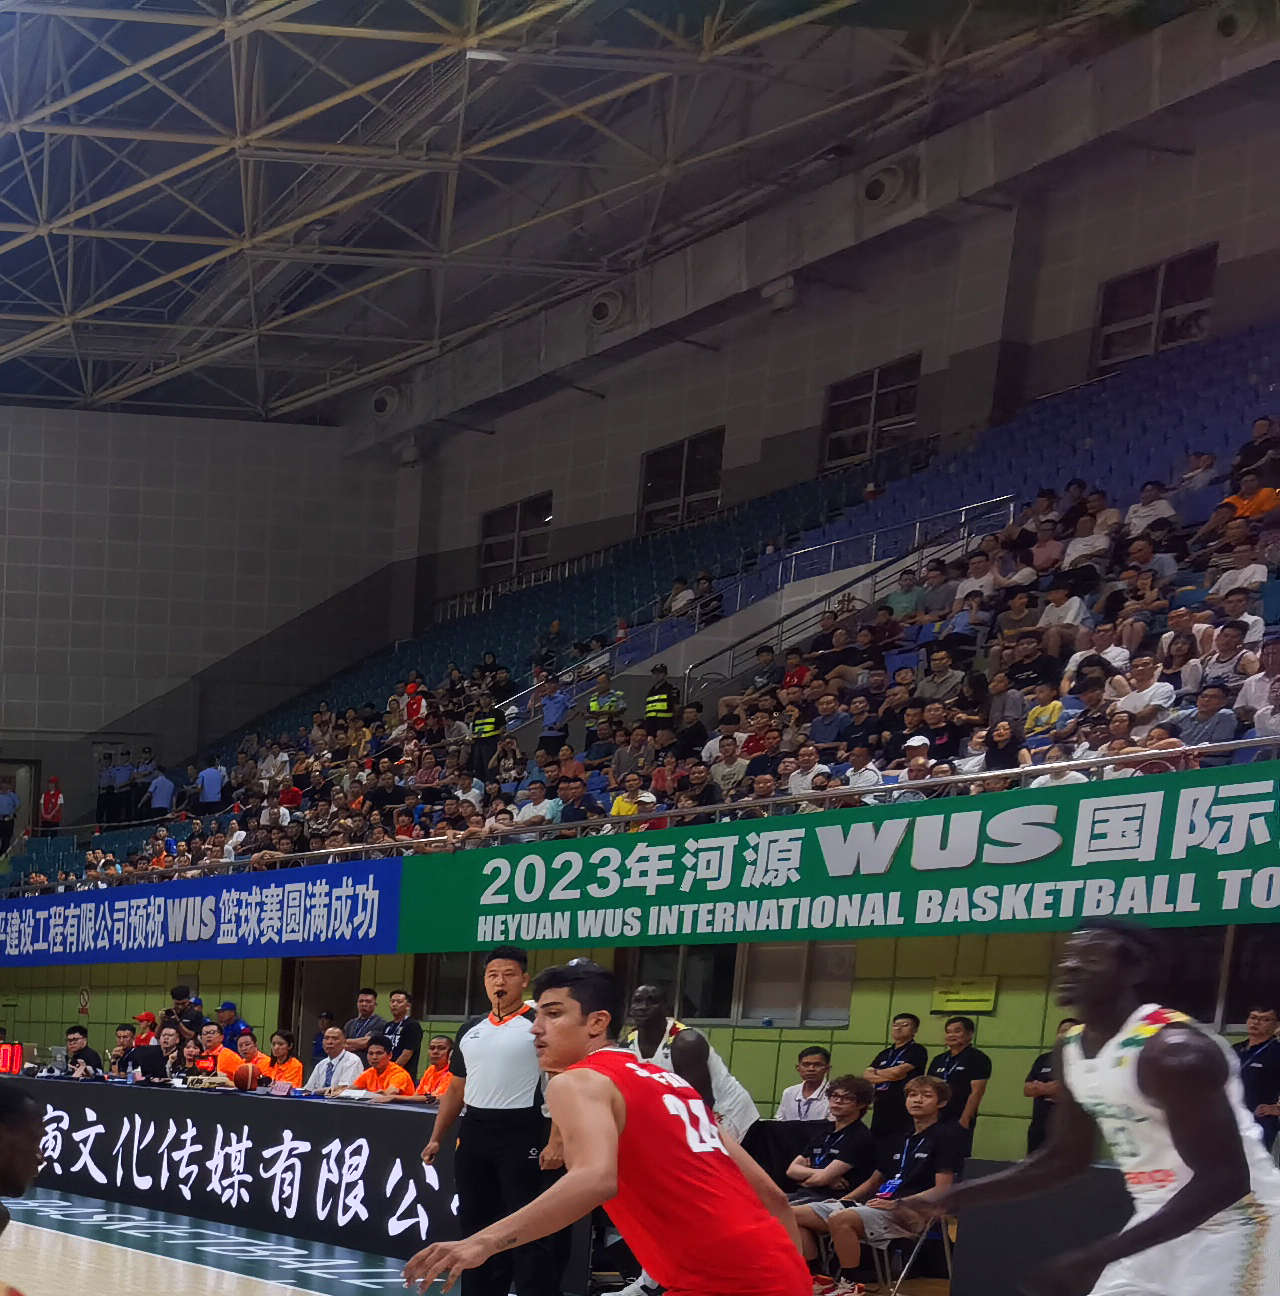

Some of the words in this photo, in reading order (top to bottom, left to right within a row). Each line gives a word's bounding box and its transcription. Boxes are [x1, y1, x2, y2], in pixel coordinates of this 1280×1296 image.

[476, 911, 572, 943] HEYUAN
[578, 906, 642, 939] WUS
[648, 892, 905, 936] INTERNATIONAL
[926, 872, 1202, 923] BASKETBALL
